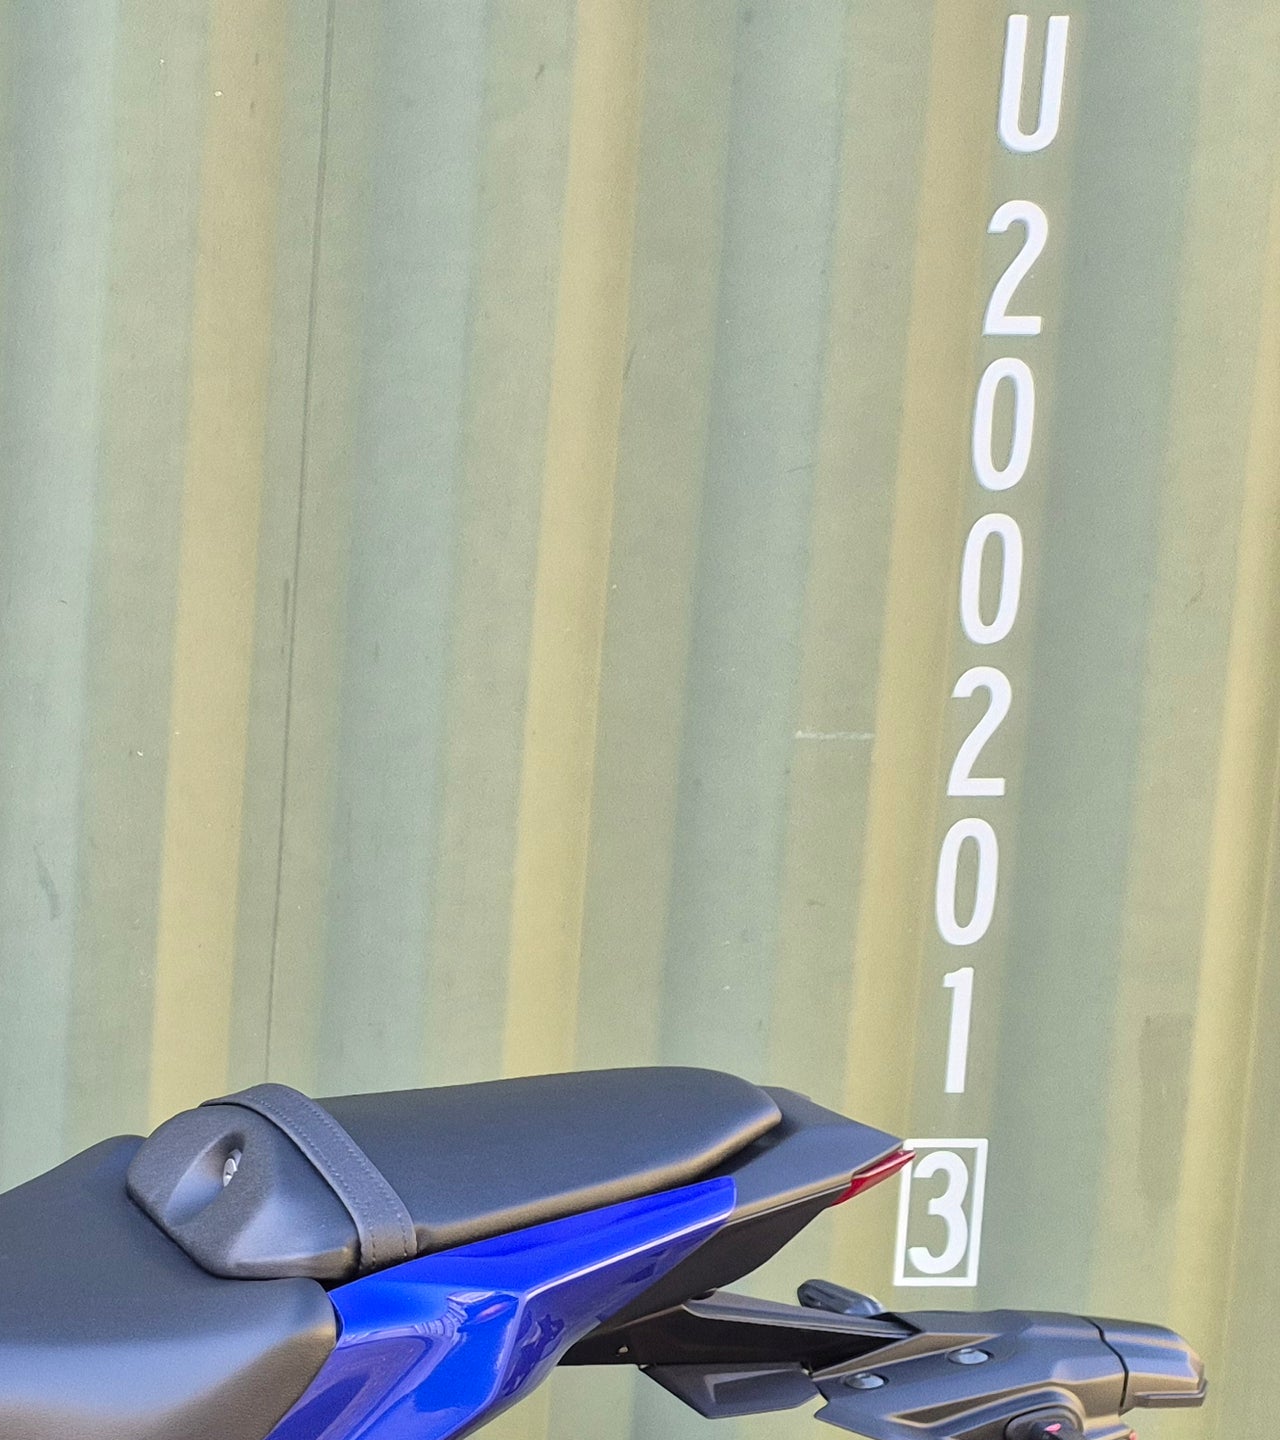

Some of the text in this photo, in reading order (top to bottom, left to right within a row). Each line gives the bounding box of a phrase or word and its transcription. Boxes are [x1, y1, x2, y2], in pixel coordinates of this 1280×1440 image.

[907, 13, 1071, 1275] U 200201 3
